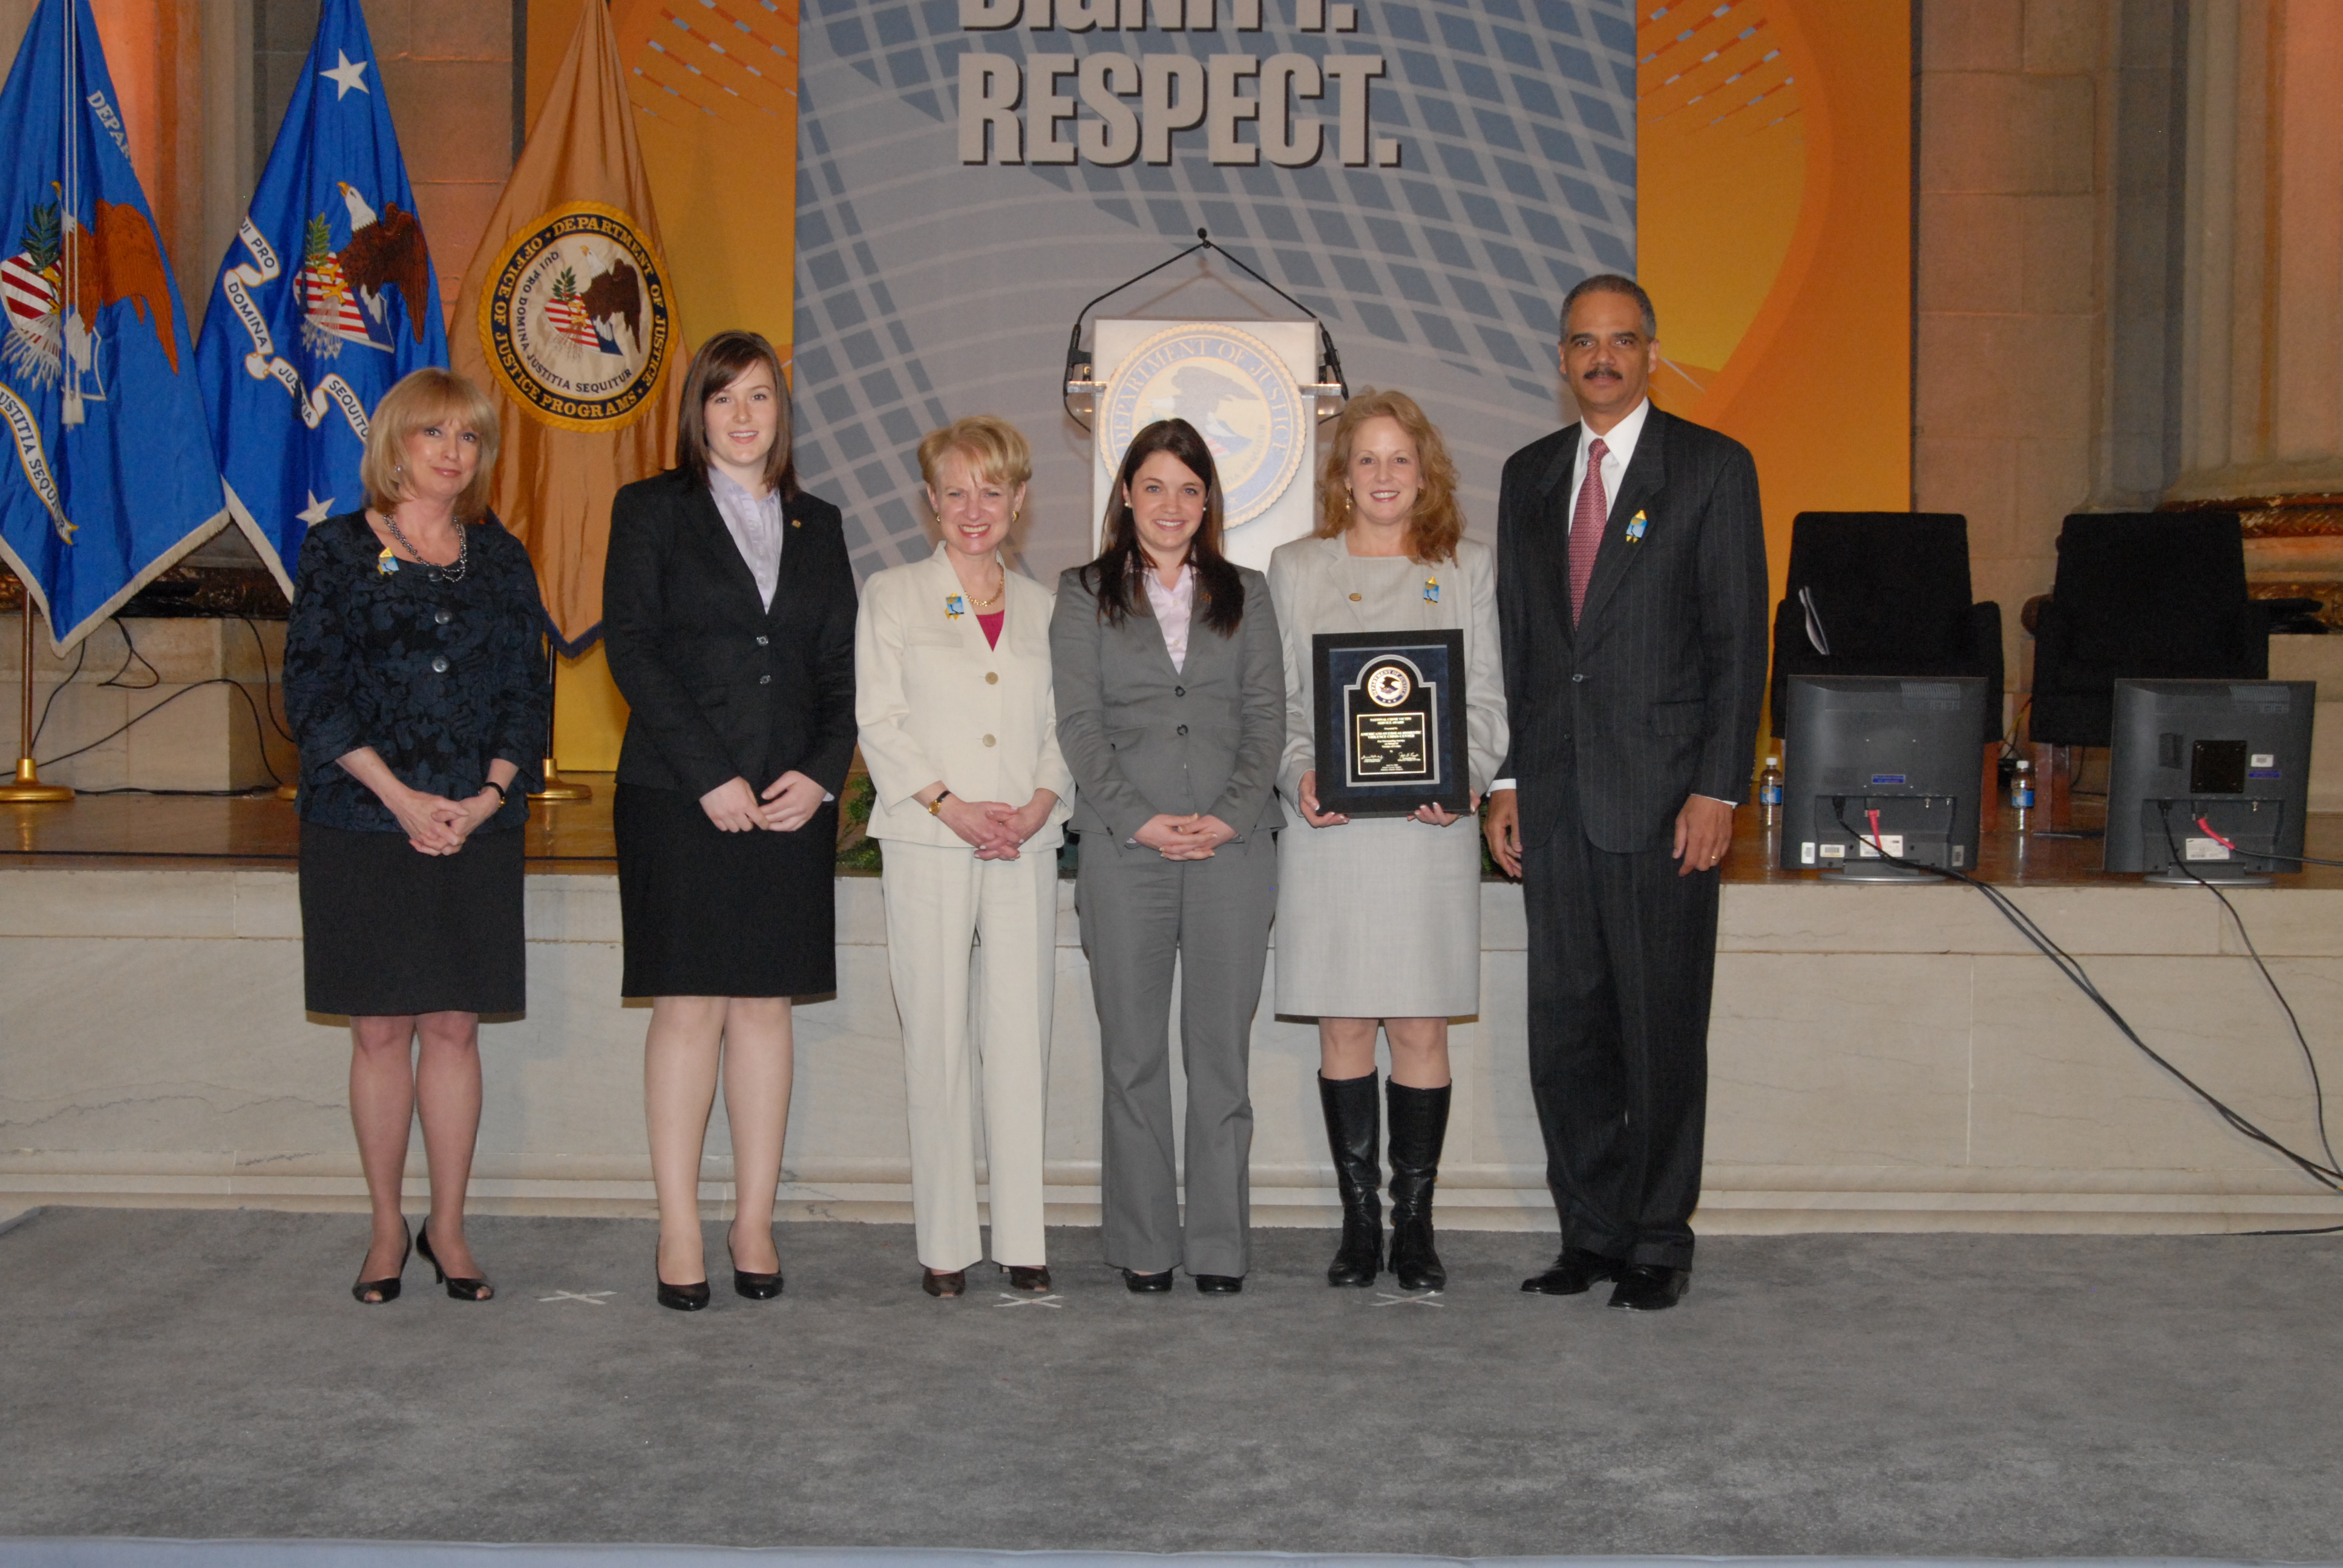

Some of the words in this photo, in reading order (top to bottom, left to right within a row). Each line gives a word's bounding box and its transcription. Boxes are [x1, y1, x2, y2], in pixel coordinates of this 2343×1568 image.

[86, 90, 133, 166] DEPAR
[958, 52, 1401, 168] RESPECT.
[251, 237, 275, 268] PRO
[497, 237, 543, 298] OFFICE
[539, 251, 559, 270] QUI
[552, 217, 654, 276] DEPARTMENT
[523, 270, 541, 293] PRO
[650, 284, 664, 308] OF
[228, 282, 267, 347] DOMINA
[494, 301, 507, 326] OF
[517, 296, 529, 351] DOMINA
[496, 332, 541, 400] JUSTICE
[526, 354, 571, 390] JUSTITIA
[641, 315, 666, 387] JUSTICE
[540, 391, 638, 417] PROGRAMS
[575, 368, 632, 393] SEQUITUR
[1115, 339, 1210, 448] DEPARTMENT
[1218, 342, 1248, 364] OF
[1250, 363, 1289, 449] JUSTICE
